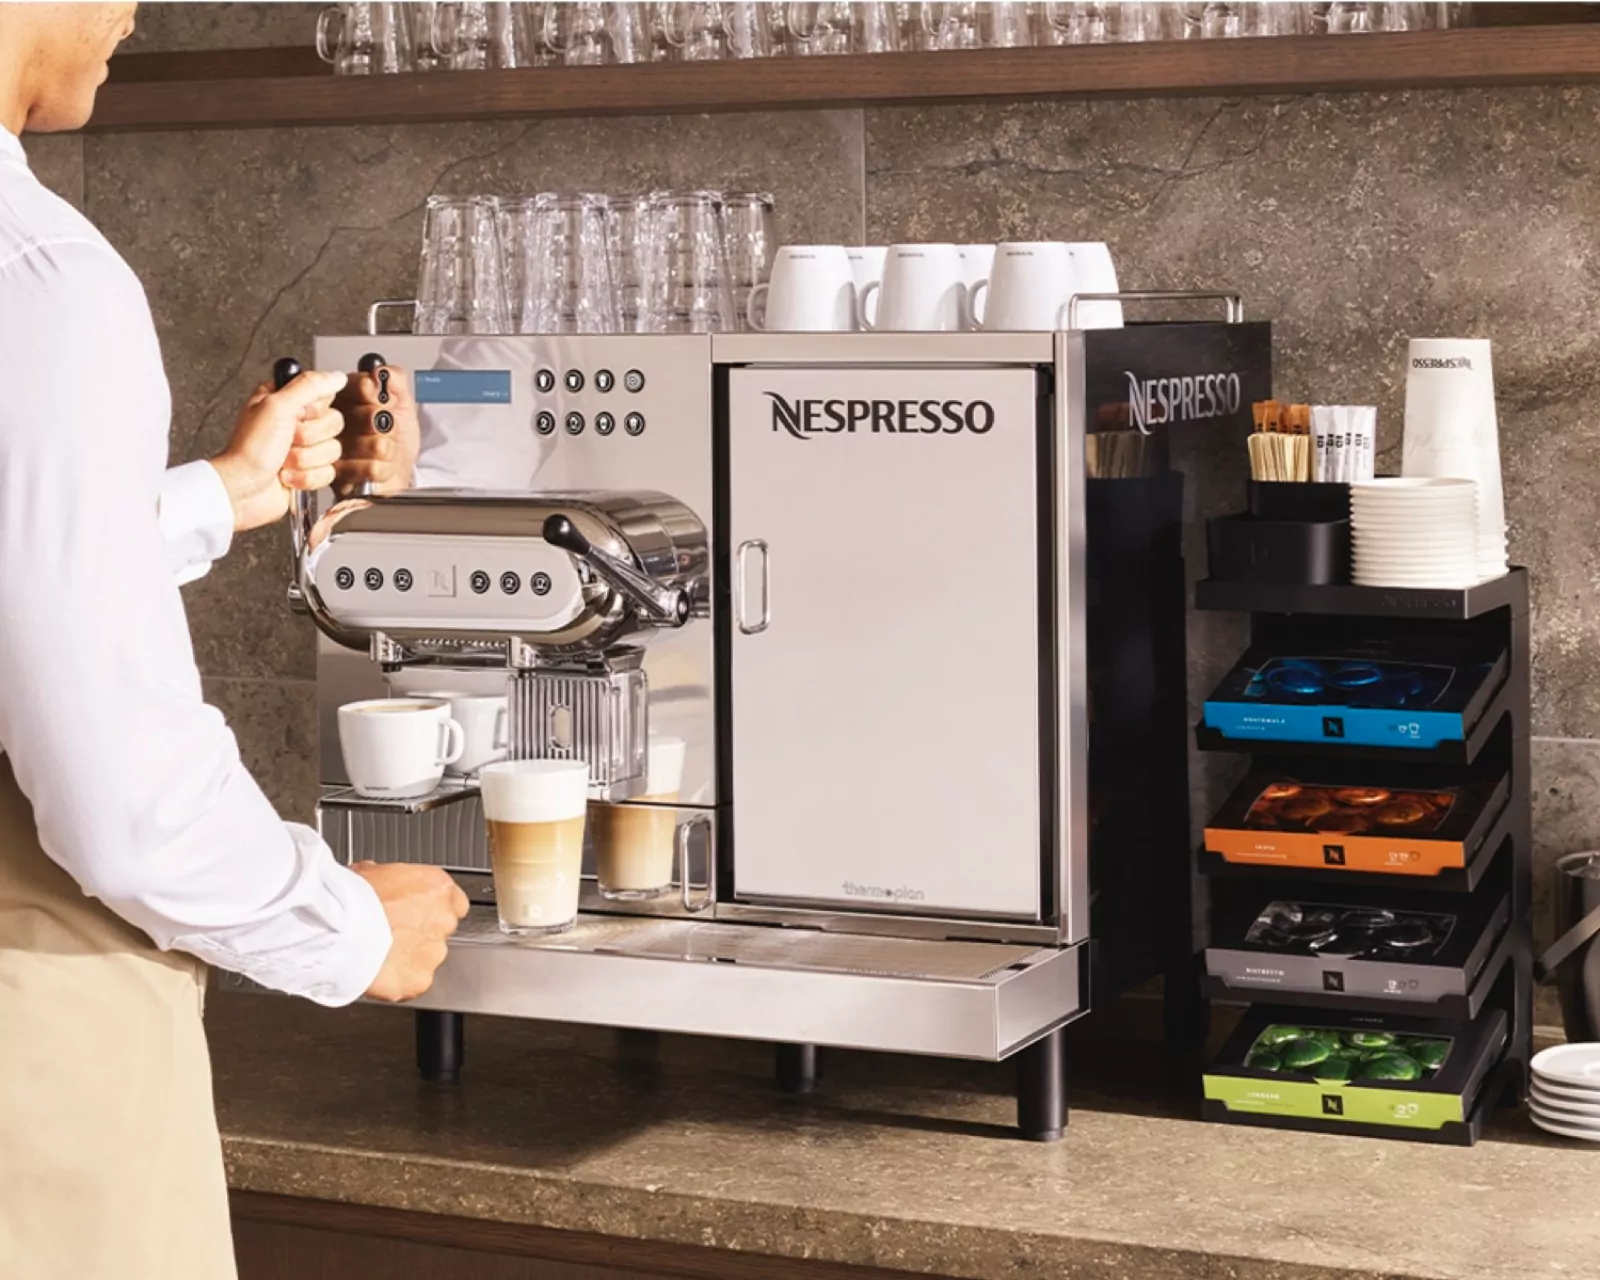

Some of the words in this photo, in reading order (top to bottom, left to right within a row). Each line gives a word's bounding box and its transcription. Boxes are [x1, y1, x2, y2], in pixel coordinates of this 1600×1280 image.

[1412, 356, 1473, 370] NESPRESSO
[762, 391, 995, 440] NESPRESSO
[1123, 371, 1241, 435] NESPRESSO
